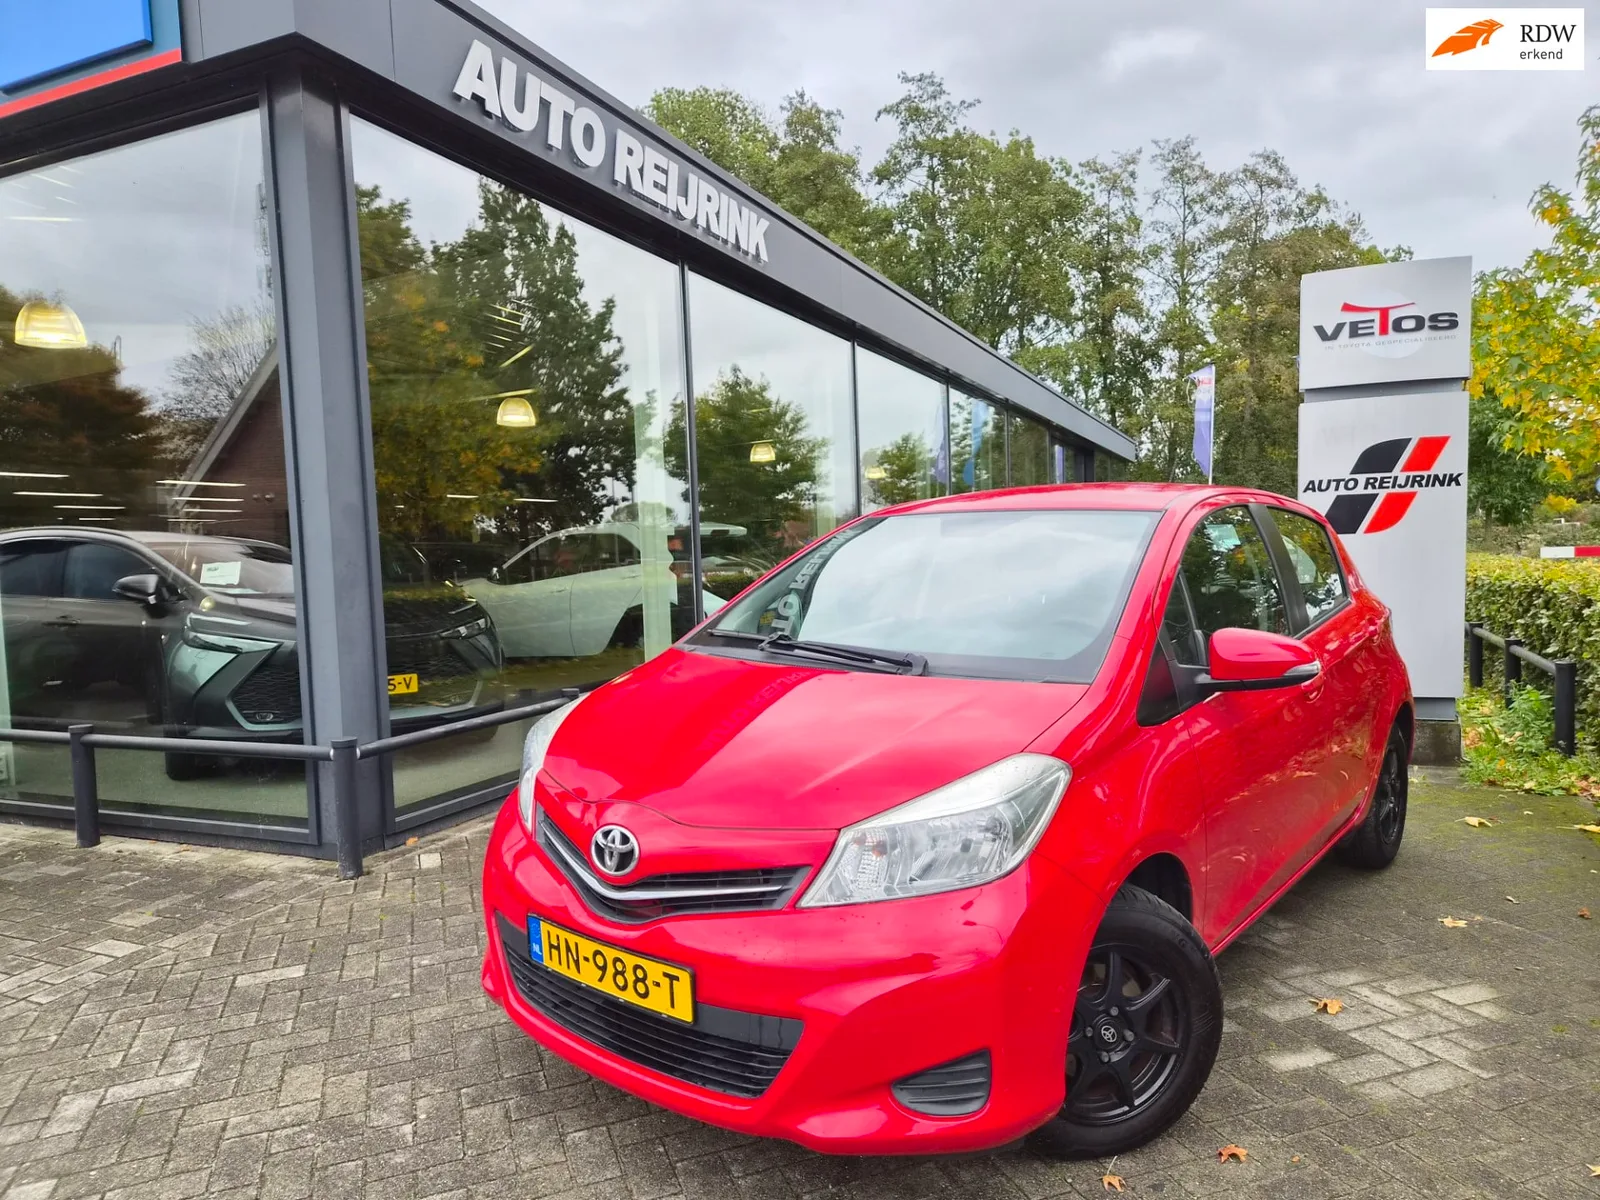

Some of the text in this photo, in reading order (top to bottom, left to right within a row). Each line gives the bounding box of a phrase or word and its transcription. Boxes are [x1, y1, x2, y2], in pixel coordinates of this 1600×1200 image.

[452, 39, 770, 263] AUTO REIJRINK
[1313, 302, 1459, 342] VETOS
[1302, 472, 1464, 493] AUTO REIJRINK
[547, 930, 680, 1009] HN-988-T
